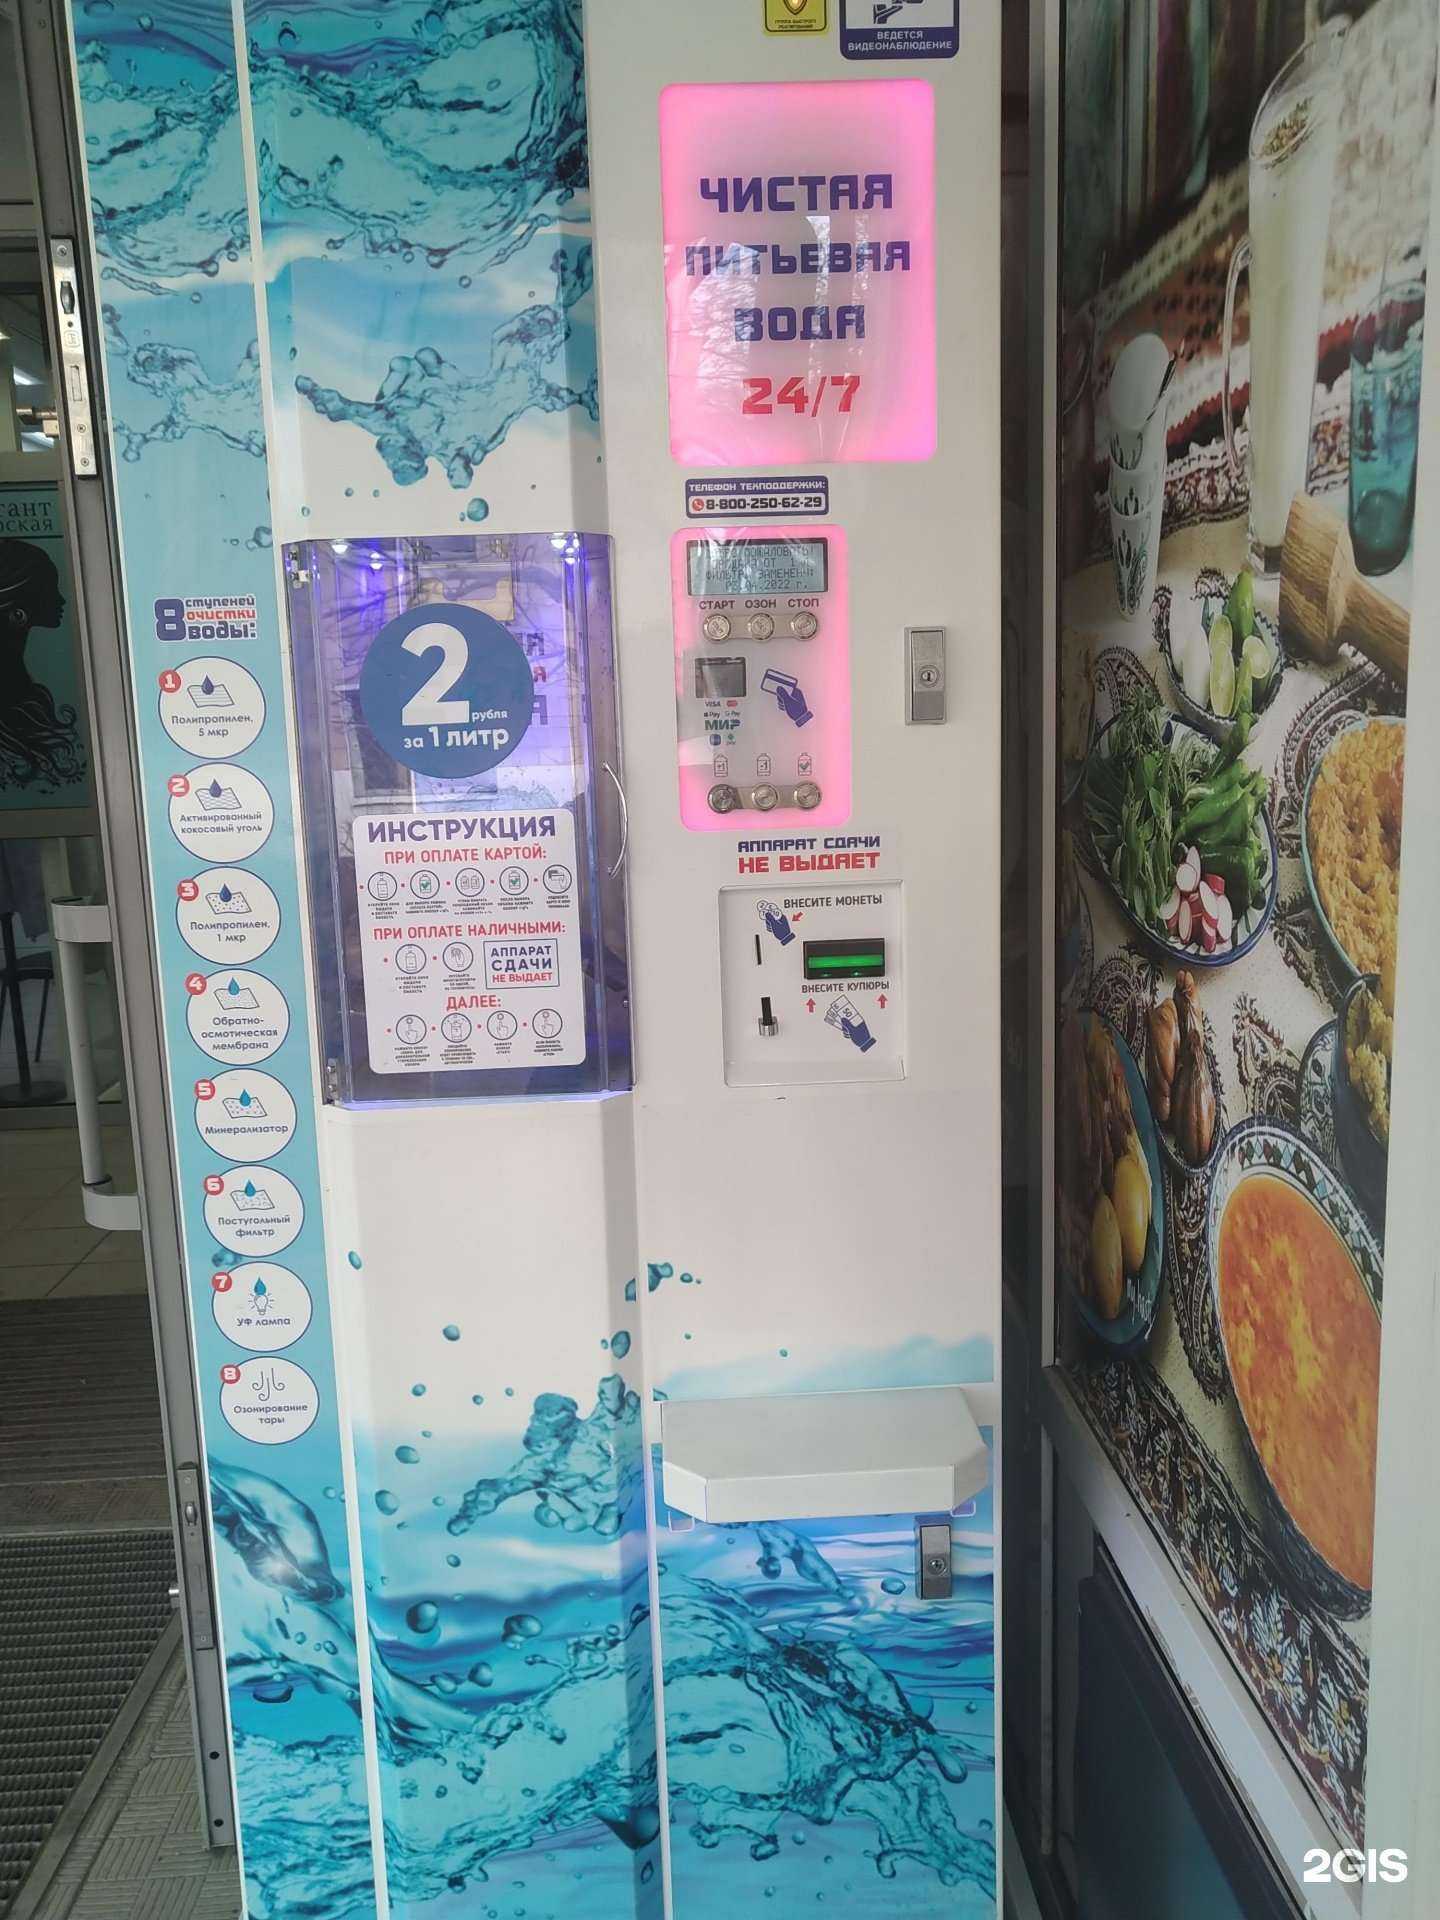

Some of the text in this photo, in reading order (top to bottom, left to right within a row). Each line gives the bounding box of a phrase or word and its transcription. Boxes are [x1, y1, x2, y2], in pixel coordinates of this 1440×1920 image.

[877, 31, 923, 40] ВЕДЕТСЯ
[848, 41, 953, 51] ВИДЕОНАБЛЮДЕНИЕ
[700, 174, 893, 213] ЧИСТАЯ
[685, 241, 910, 276] ПИТЬЕВАЯ
[734, 304, 866, 342] ВОДА
[742, 375, 861, 417] 24/7
[689, 481, 826, 492] ТЕЛЕФОН ТЕХПОДДЕРЖКИ:
[0, 502, 51, 517] ант
[706, 497, 822, 510] 8-800-250-62-29
[705, 568, 751, 581] ФИЛЬТР
[699, 598, 820, 610] СТАРТ ОЗОН СТОП
[154, 598, 187, 641] 8
[401, 622, 470, 726] 2
[164, 673, 176, 689] 1
[472, 709, 508, 722] рубля
[704, 719, 741, 731] МИР
[199, 728, 229, 738] 5 мкр
[403, 727, 510, 750] за 1 литр
[172, 778, 186, 793] 2
[180, 811, 262, 822] Активированный
[181, 823, 263, 834] кокосовый уголь
[367, 815, 556, 843] ИНСТРУКЦИЯ
[738, 835, 881, 852] АППАРАТ СДАЧИ
[384, 843, 547, 864] ПРИ ОПЛАТЕ КАРТОЙ:
[738, 852, 881, 873] НЕ ВЫДАЕТ
[181, 882, 194, 898] 3
[784, 894, 883, 909] ВНЕСИТЕ МОНЕТЫ
[373, 921, 566, 940] ПРИ ОПЛАТЕ НАЛИЧНЫМИ:
[226, 933, 247, 944] мкр
[490, 945, 552, 957] АППАРАТ
[491, 957, 552, 973] СДАЧИ
[188, 976, 203, 991] 4
[492, 971, 553, 983] НЕ ВЫДАЕТ
[801, 981, 890, 994] ВНЕСИТЕ КУПЮРЫ
[446, 994, 502, 1011] ДАЛЕЕ:
[212, 1016, 265, 1027] Обратно-
[201, 1028, 279, 1039] осмотическая
[212, 1040, 269, 1050] мембрана
[197, 1082, 212, 1098] 5
[205, 1124, 289, 1136] Минерализатор
[206, 1177, 222, 1193] 6
[218, 1214, 291, 1227] Постугольный
[235, 1227, 275, 1238] фильтр
[215, 1275, 229, 1289] 7
[237, 1317, 291, 1327] УФ лампа
[223, 1367, 238, 1382] 8
[233, 1402, 309, 1414] Озонирование
[259, 1415, 286, 1425] тары
